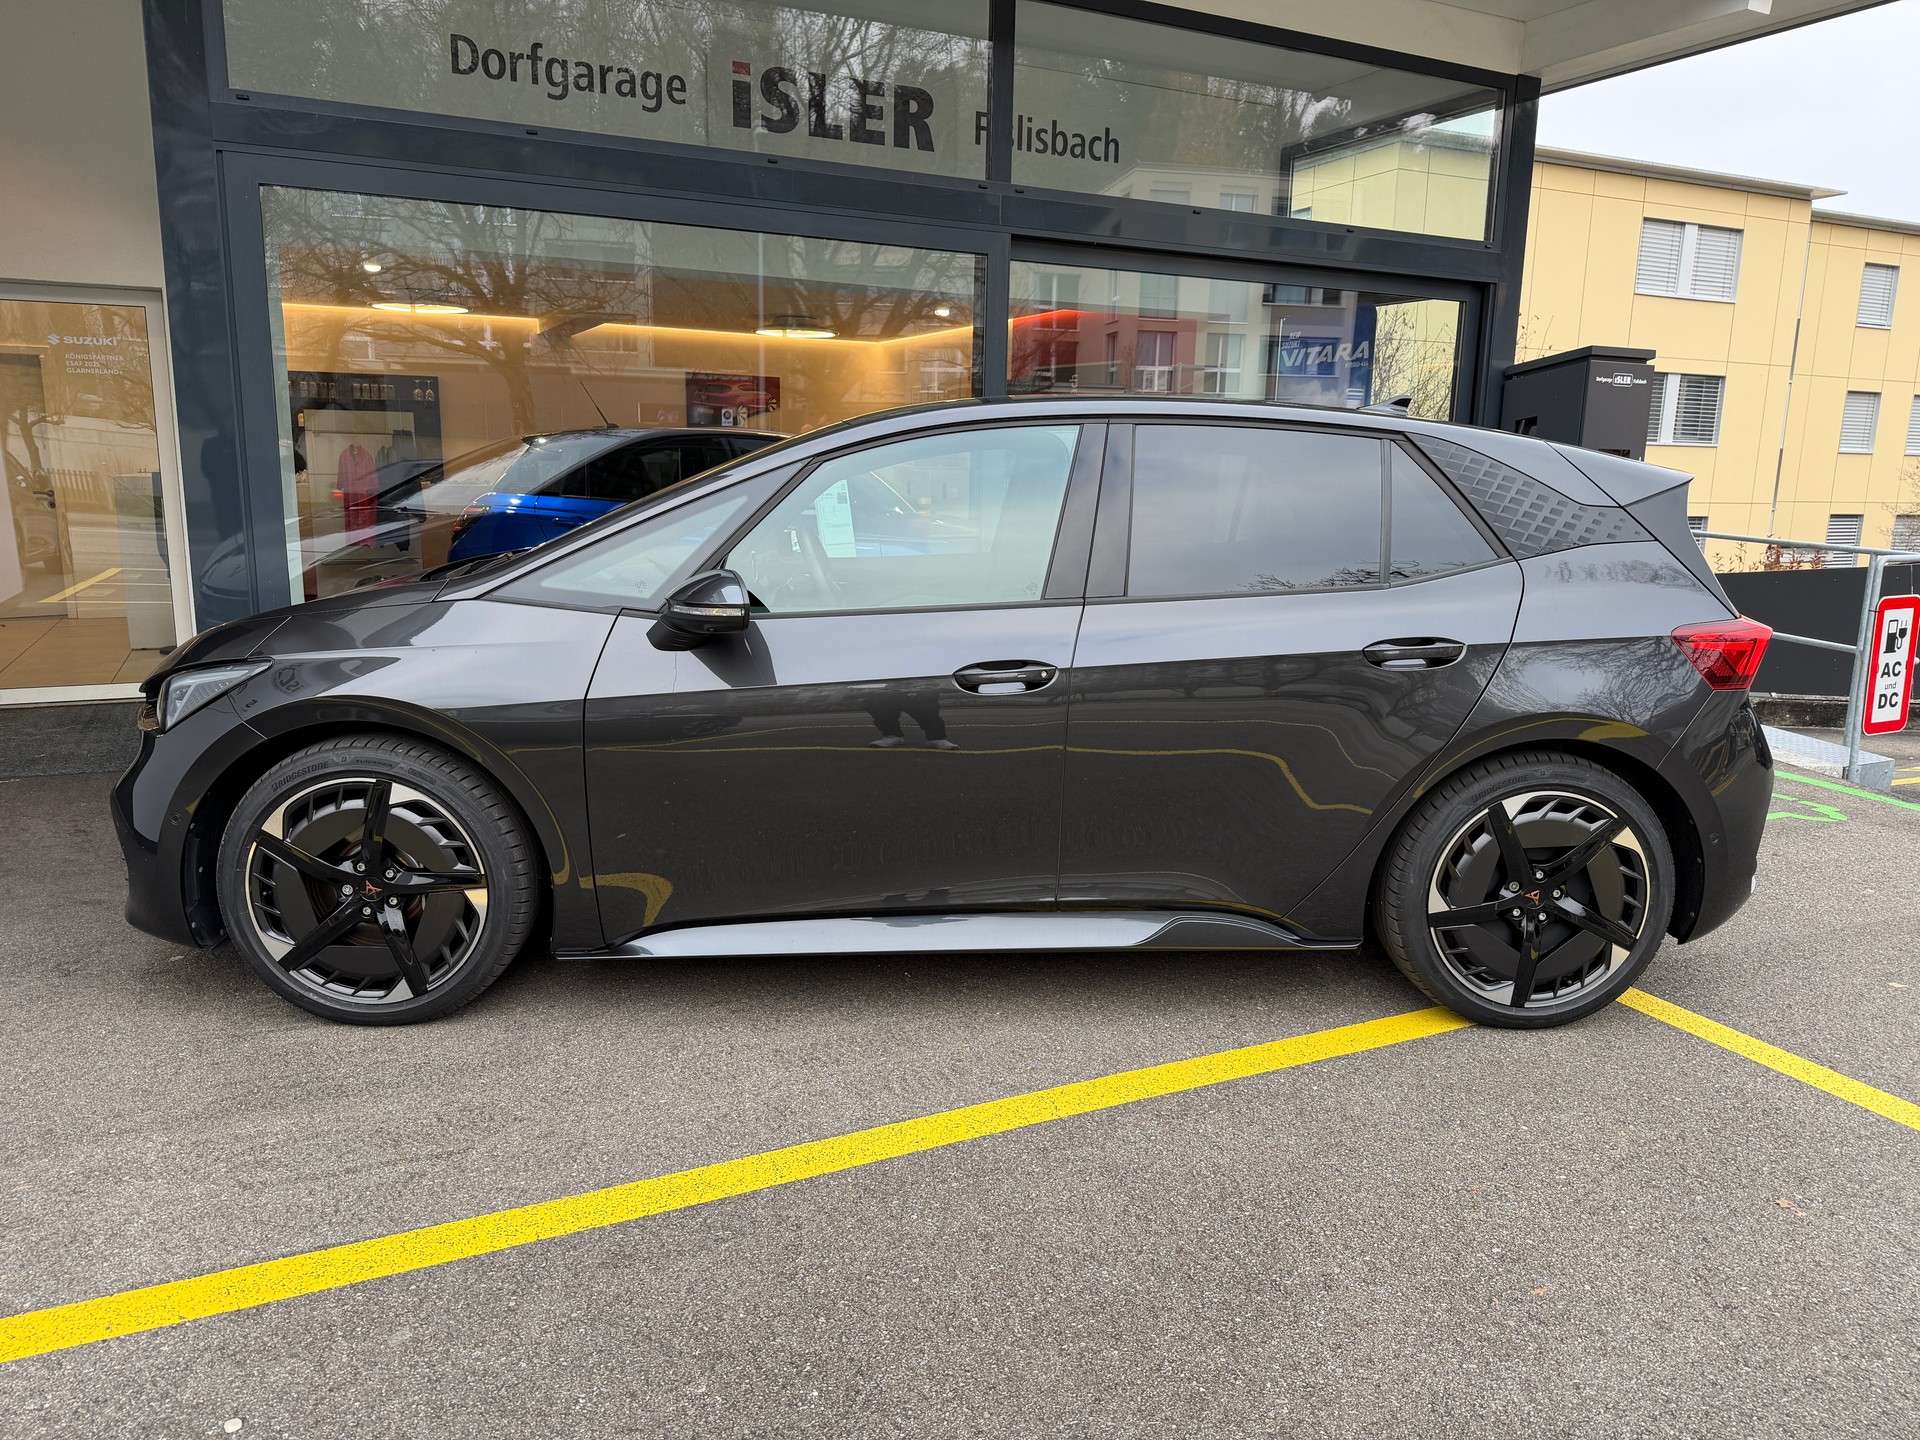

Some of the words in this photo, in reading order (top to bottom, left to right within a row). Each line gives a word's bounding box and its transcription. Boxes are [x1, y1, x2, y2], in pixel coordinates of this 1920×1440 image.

[450, 33, 687, 113] Dorfgarage
[731, 60, 935, 152] iSLER
[975, 111, 1120, 163] Flisbach
[63, 336, 117, 346] SUZUKI
[1281, 340, 1301, 349] SUZUKI
[65, 353, 124, 361] KÖNIGSPARTNER
[1281, 340, 1370, 367] VITARA
[1880, 661, 1902, 678] AC
[1884, 681, 1897, 690] und
[1877, 692, 1899, 709] DC
[271, 761, 329, 793] BRIDGESTONE
